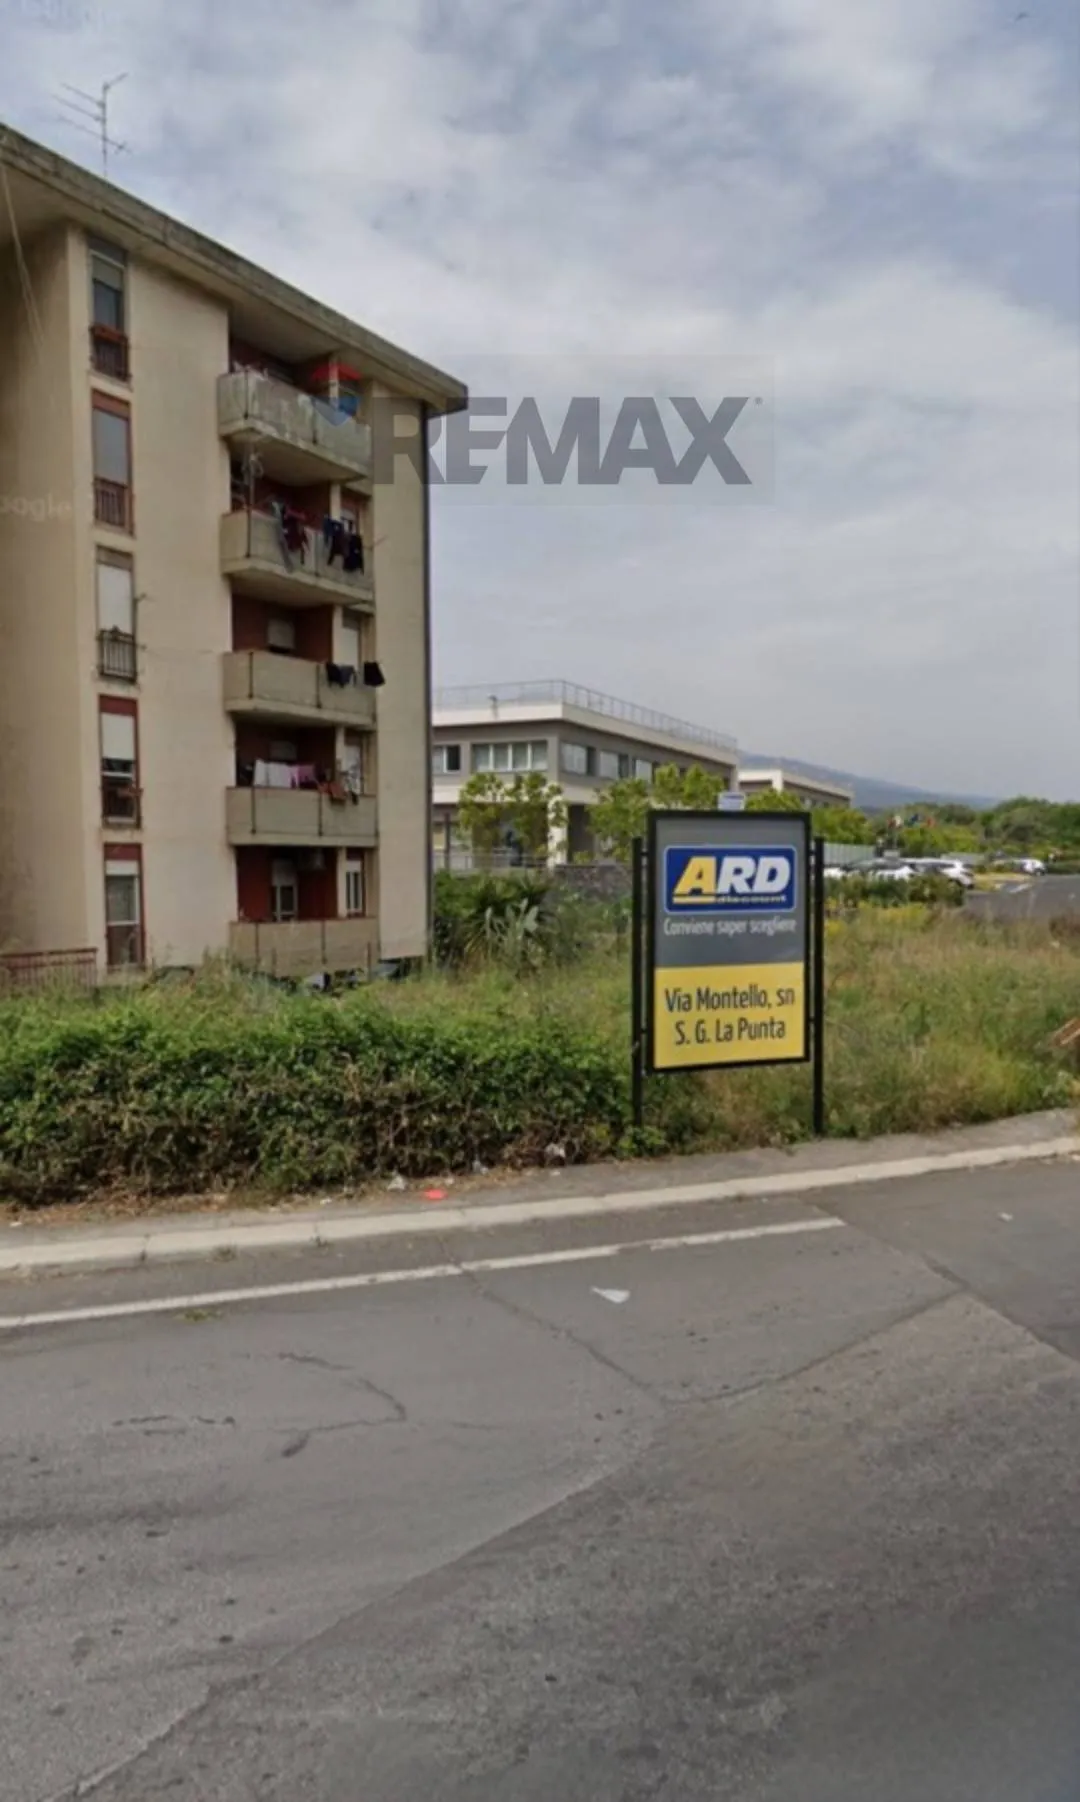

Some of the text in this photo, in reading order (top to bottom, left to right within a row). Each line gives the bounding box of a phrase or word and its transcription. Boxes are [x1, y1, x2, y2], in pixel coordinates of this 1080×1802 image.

[673, 856, 791, 895] ARD
[664, 916, 797, 937] Conviene saper scegliere
[664, 984, 795, 1012] Via Montello, sn
[675, 1016, 786, 1045] S. G. La Punta
